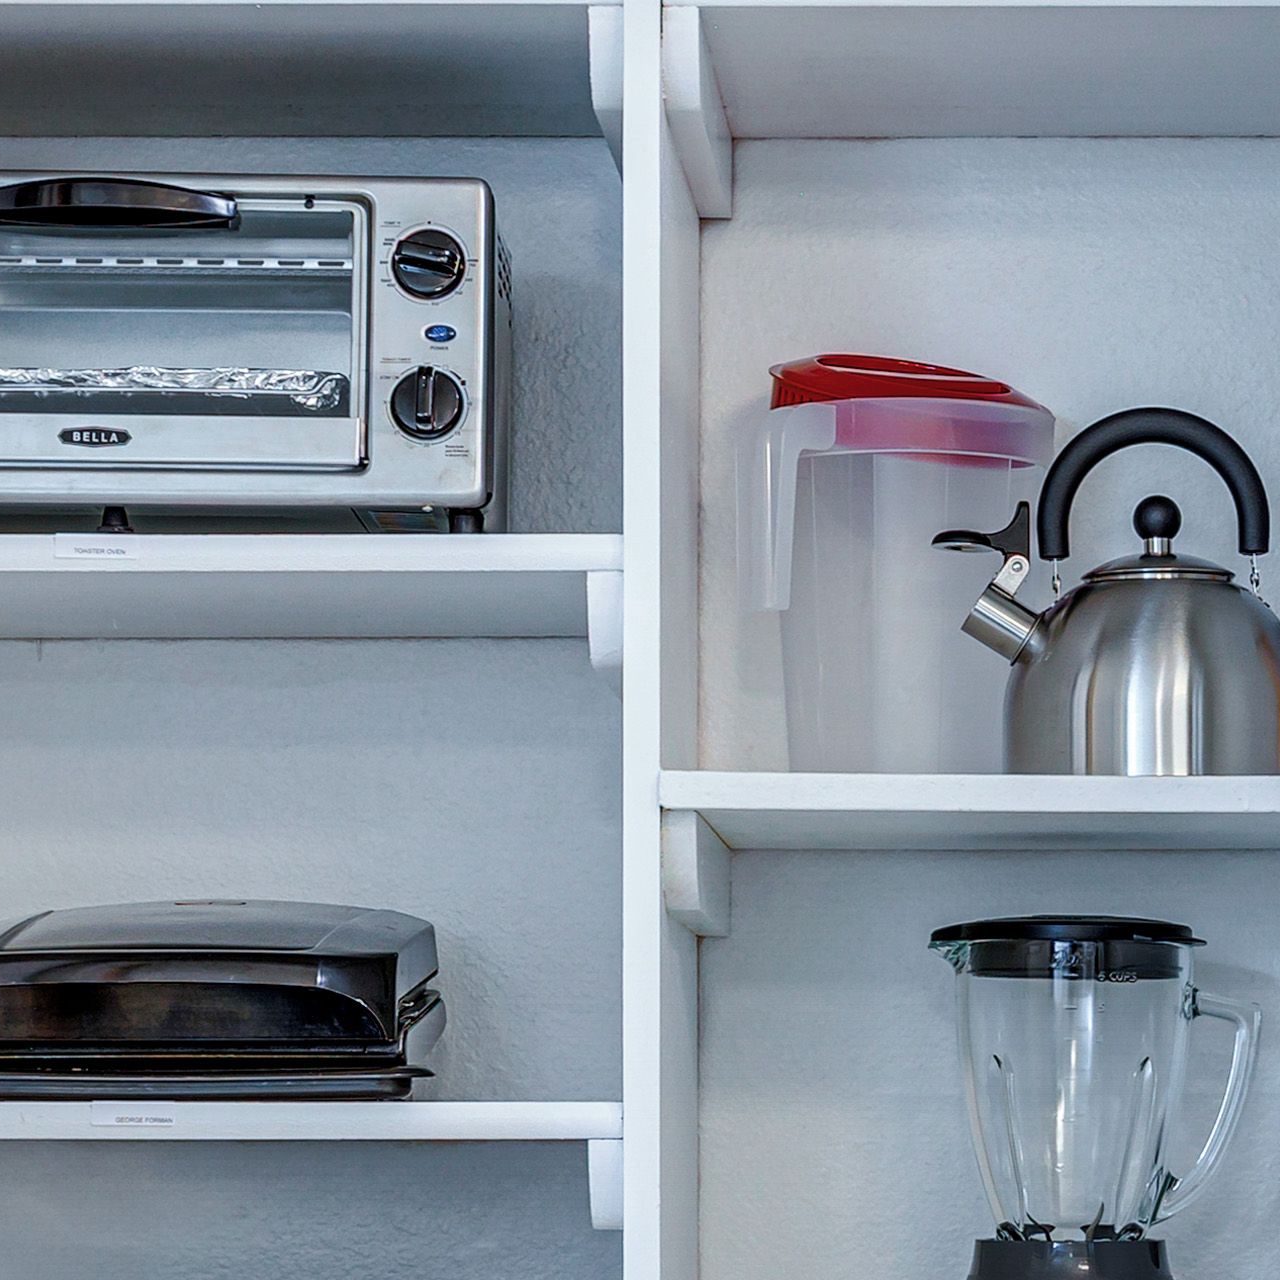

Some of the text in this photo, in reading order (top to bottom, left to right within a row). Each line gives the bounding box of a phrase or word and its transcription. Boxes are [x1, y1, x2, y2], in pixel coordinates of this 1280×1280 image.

[72, 431, 119, 442] BELLA
[74, 547, 105, 555] TOASTER
[1109, 971, 1138, 983] CUPS
